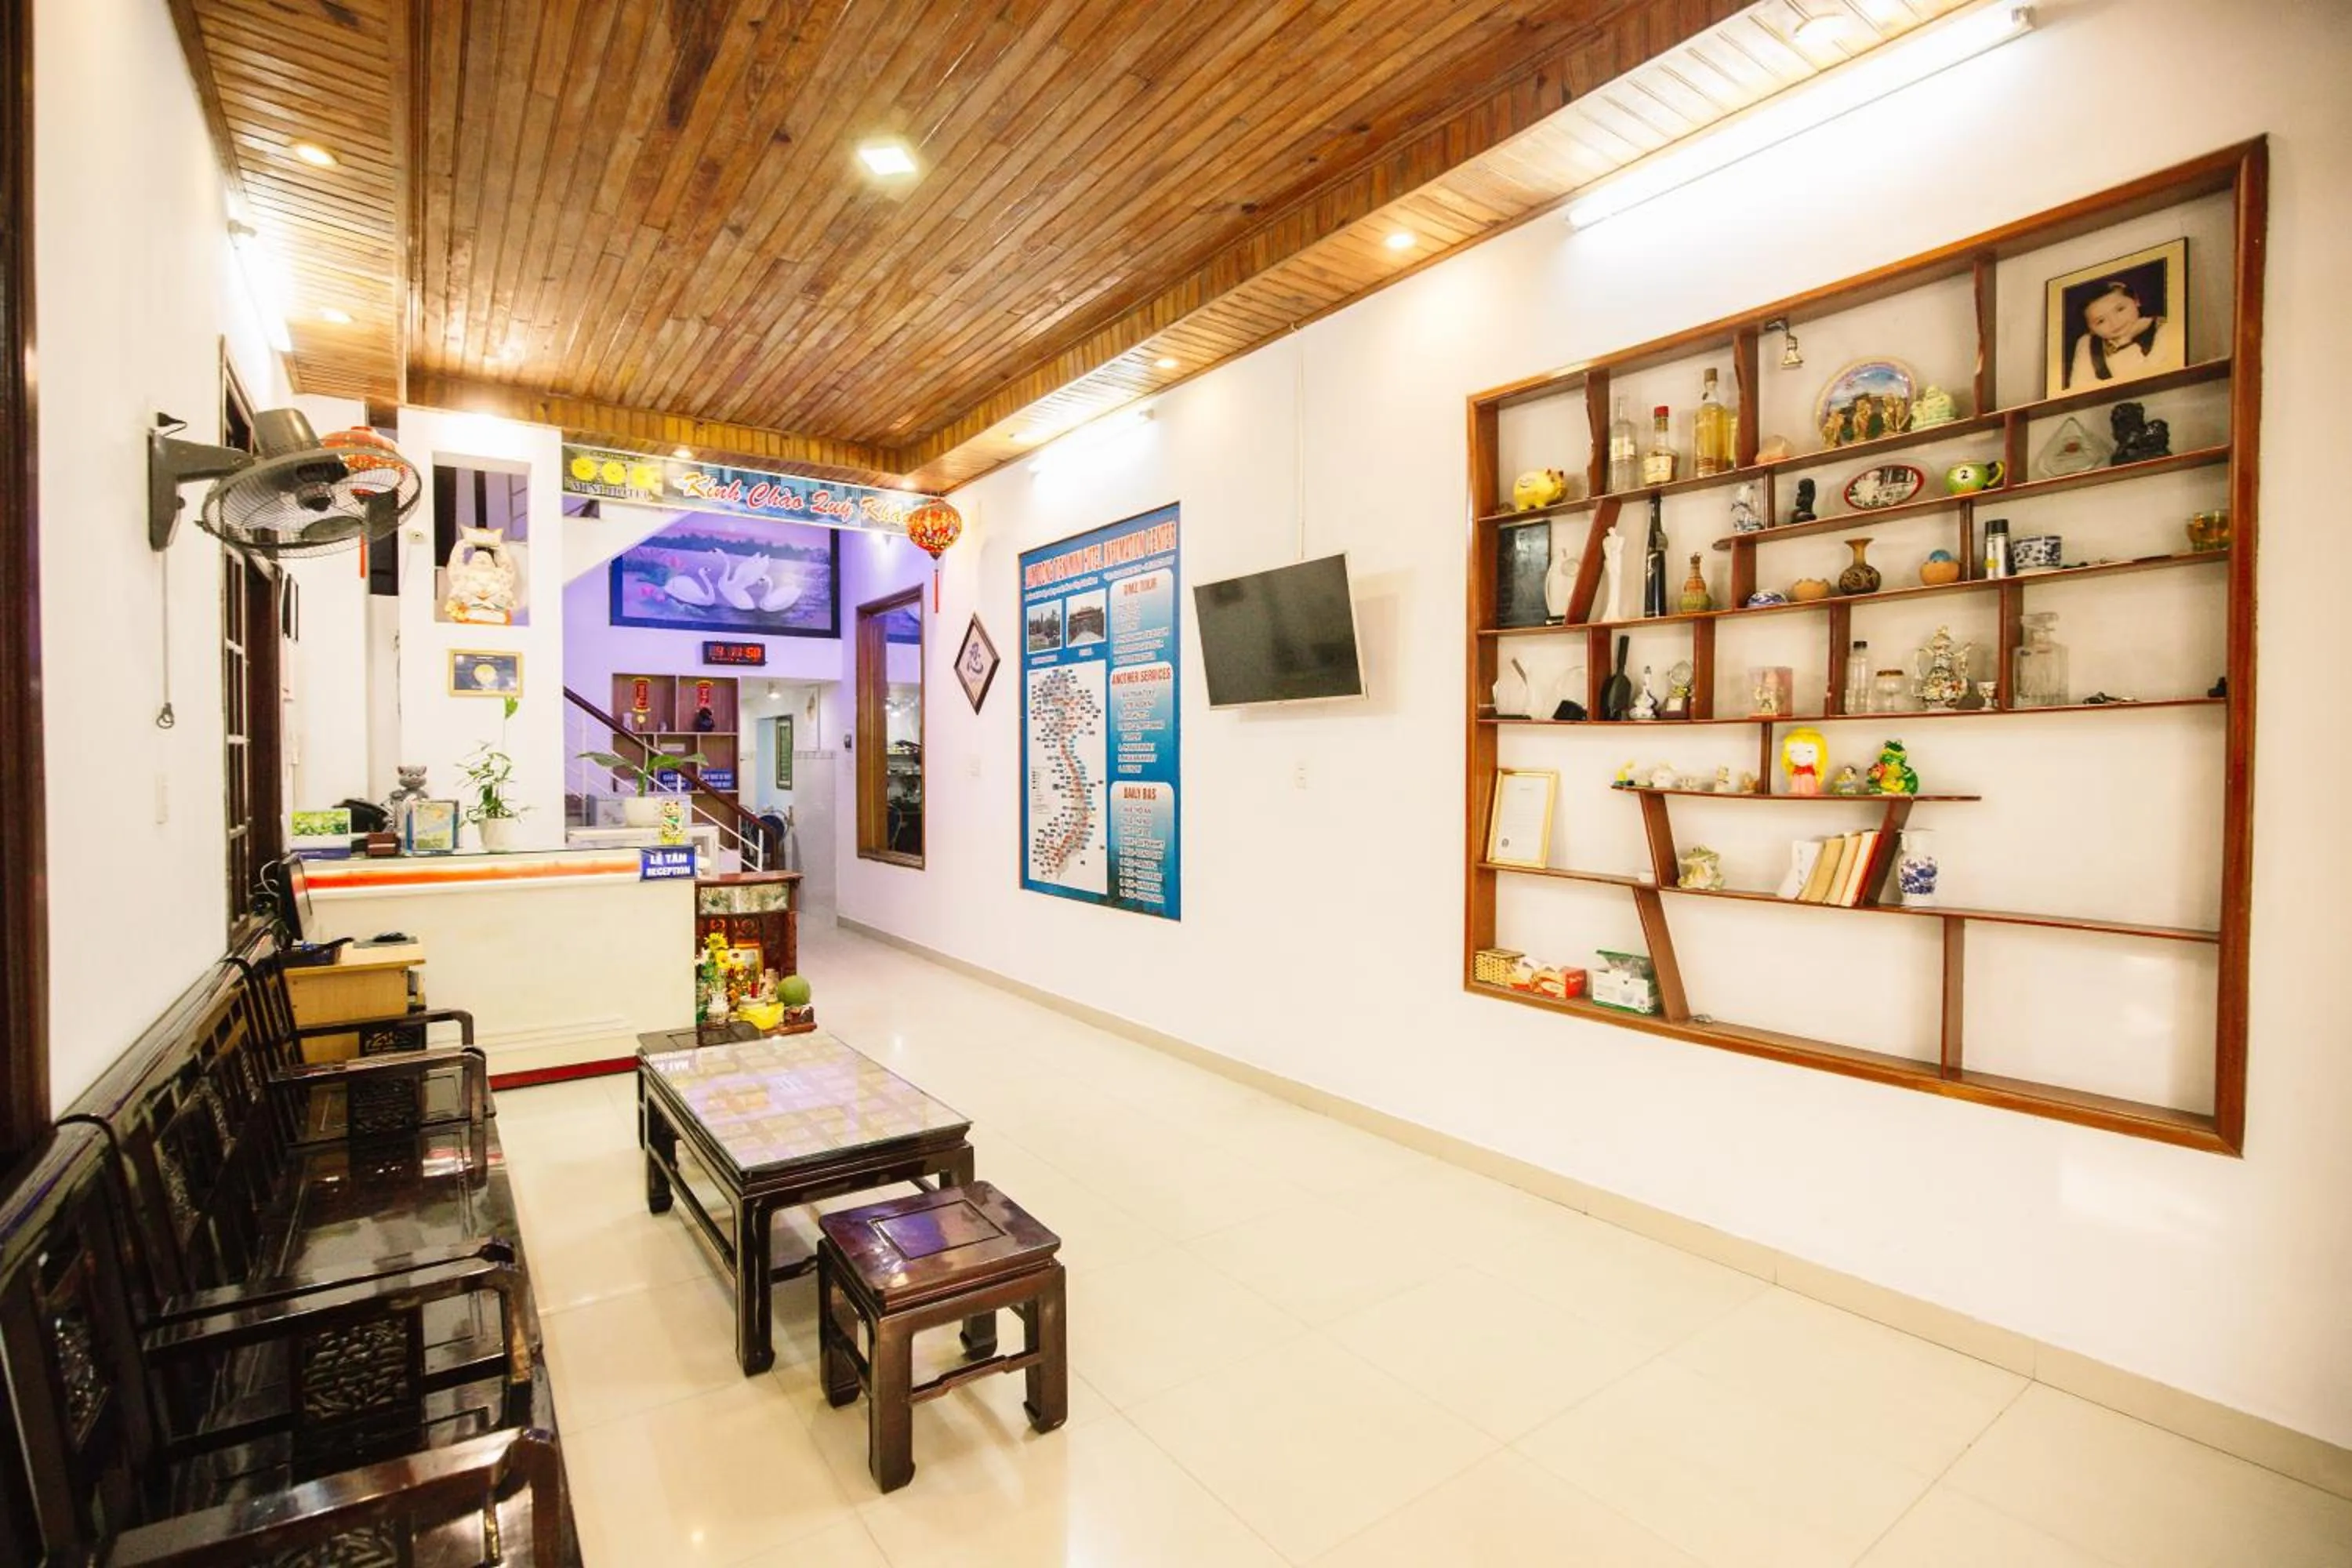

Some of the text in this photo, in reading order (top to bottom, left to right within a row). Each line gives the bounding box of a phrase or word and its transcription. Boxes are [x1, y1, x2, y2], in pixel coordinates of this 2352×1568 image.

[1961, 470, 1969, 479] 2
[747, 481, 804, 510] Chào
[810, 490, 854, 522] Quý
[1123, 582, 1139, 596] DMZ
[1112, 666, 1171, 685] ANOTHER SERVICES
[1123, 786, 1157, 800] DAILY BUS
[646, 865, 691, 877] RECEPTION
